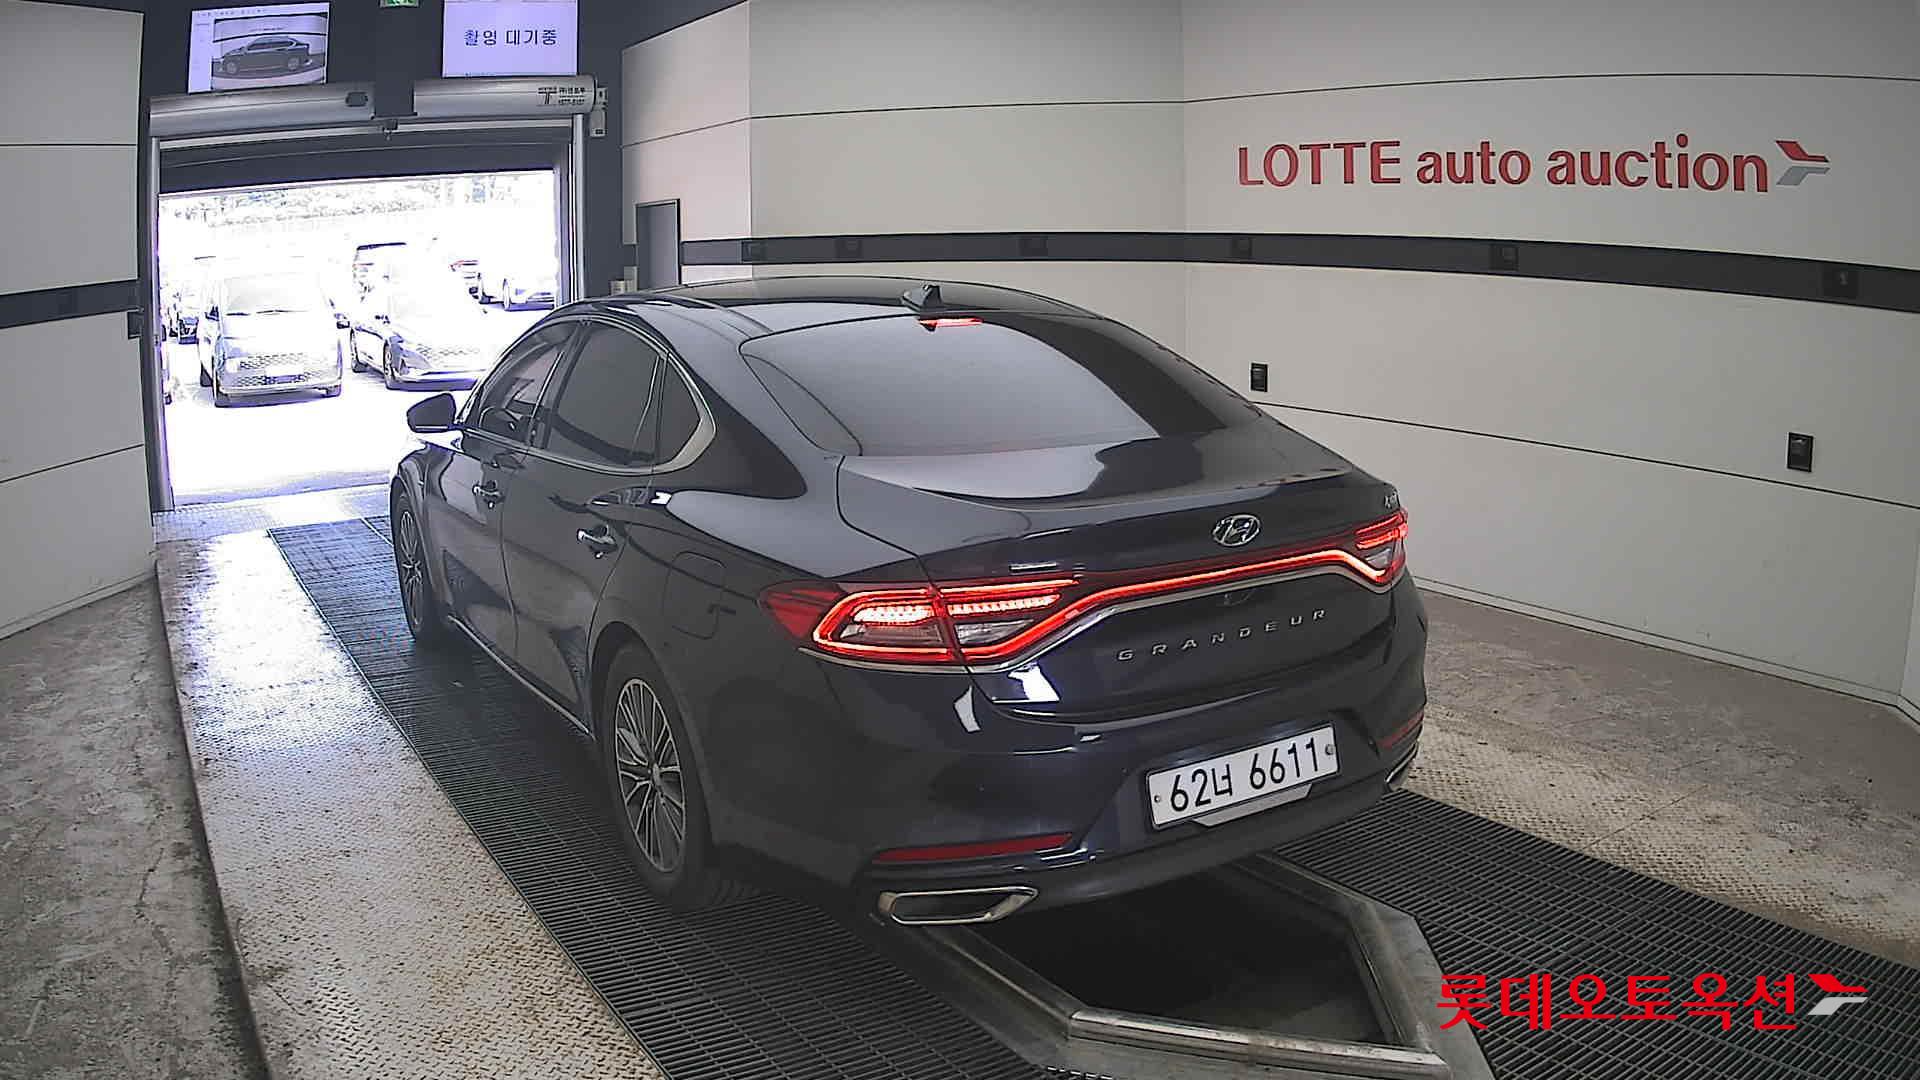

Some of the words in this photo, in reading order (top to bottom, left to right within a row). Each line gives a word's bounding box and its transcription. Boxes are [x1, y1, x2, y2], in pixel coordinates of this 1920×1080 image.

[464, 29, 497, 46] 촬영
[505, 29, 558, 46] 대기중
[1238, 140, 1400, 187] LOTTE
[1416, 141, 1531, 186] auto
[1546, 133, 1768, 193] auction
[1117, 609, 1326, 661] GRANDEUR
[1170, 763, 1233, 812] 62너
[1249, 737, 1319, 790] 6611
